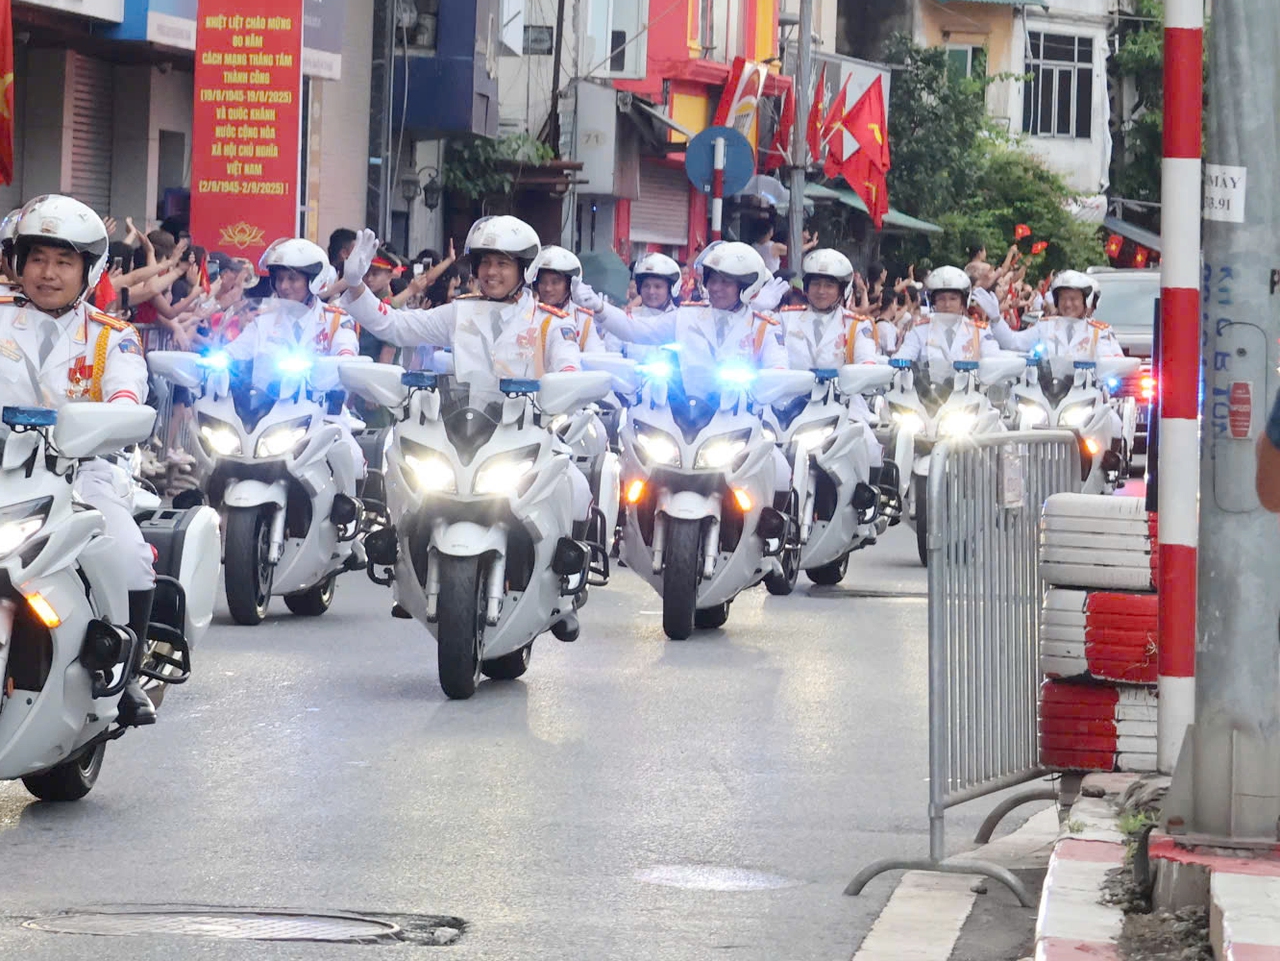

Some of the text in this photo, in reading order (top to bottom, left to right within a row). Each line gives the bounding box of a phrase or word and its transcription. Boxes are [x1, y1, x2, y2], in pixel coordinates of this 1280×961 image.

[205, 15, 227, 30] NHIỆT
[228, 15, 244, 31] LIỆT
[245, 15, 266, 30] CHÀO
[267, 16, 292, 30] MỪNG
[245, 33, 263, 47] NĂM
[202, 51, 223, 66] CÁCH
[224, 53, 248, 68] MẠNG
[249, 51, 274, 67] THÁNG
[275, 52, 293, 67] TÁM
[223, 69, 270, 84] THÀNH CÔNG
[216, 106, 276, 121] VÀ QUỐC KHÁNH
[226, 160, 263, 177] VIỆT NAM
